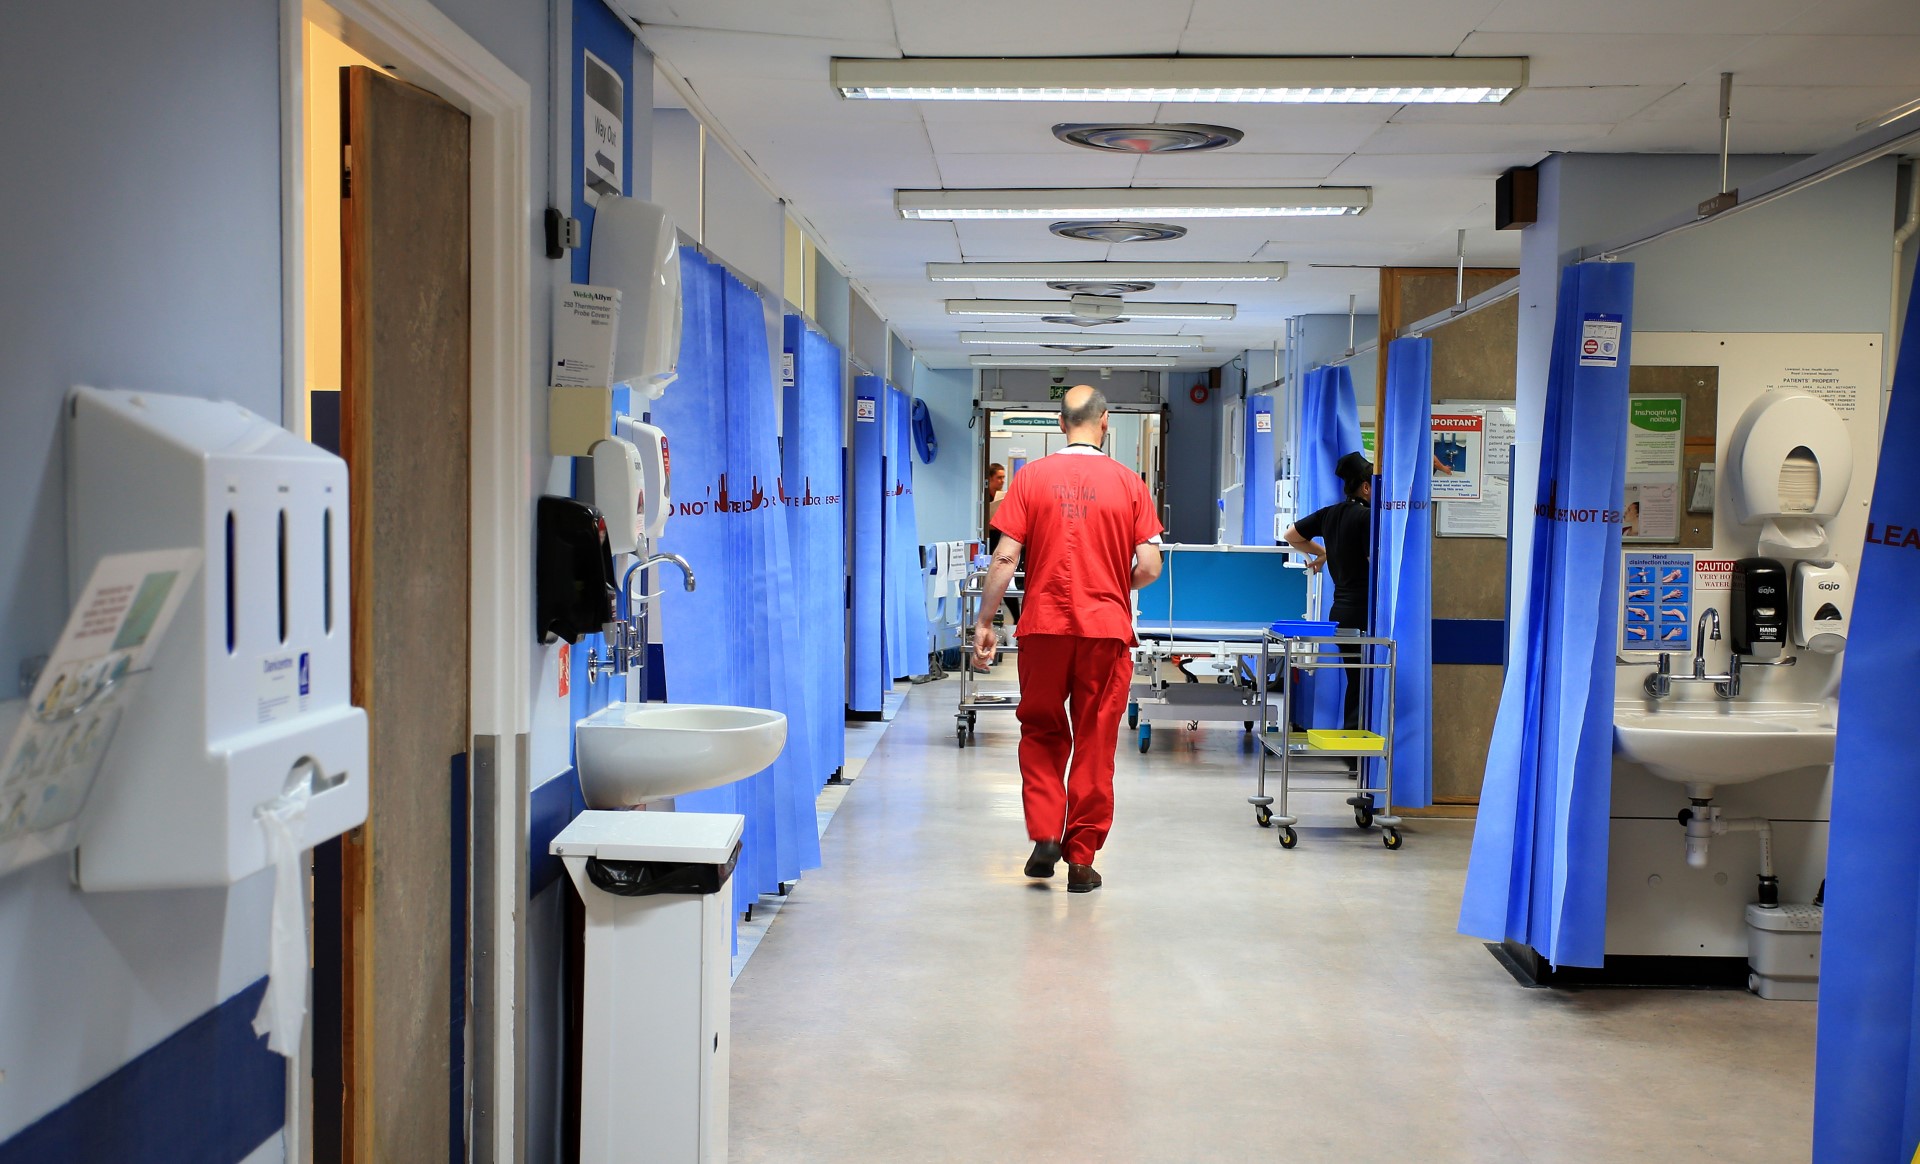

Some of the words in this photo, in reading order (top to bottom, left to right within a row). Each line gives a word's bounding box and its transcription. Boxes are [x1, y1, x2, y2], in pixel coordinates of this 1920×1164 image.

[594, 115, 606, 143] Way
[607, 125, 616, 147] Out
[574, 302, 611, 312] Thermometer
[590, 310, 610, 319] Covers
[1052, 485, 1097, 500] TRAUMA
[1060, 503, 1088, 519] TEAM
[1570, 510, 1598, 522] NOT
